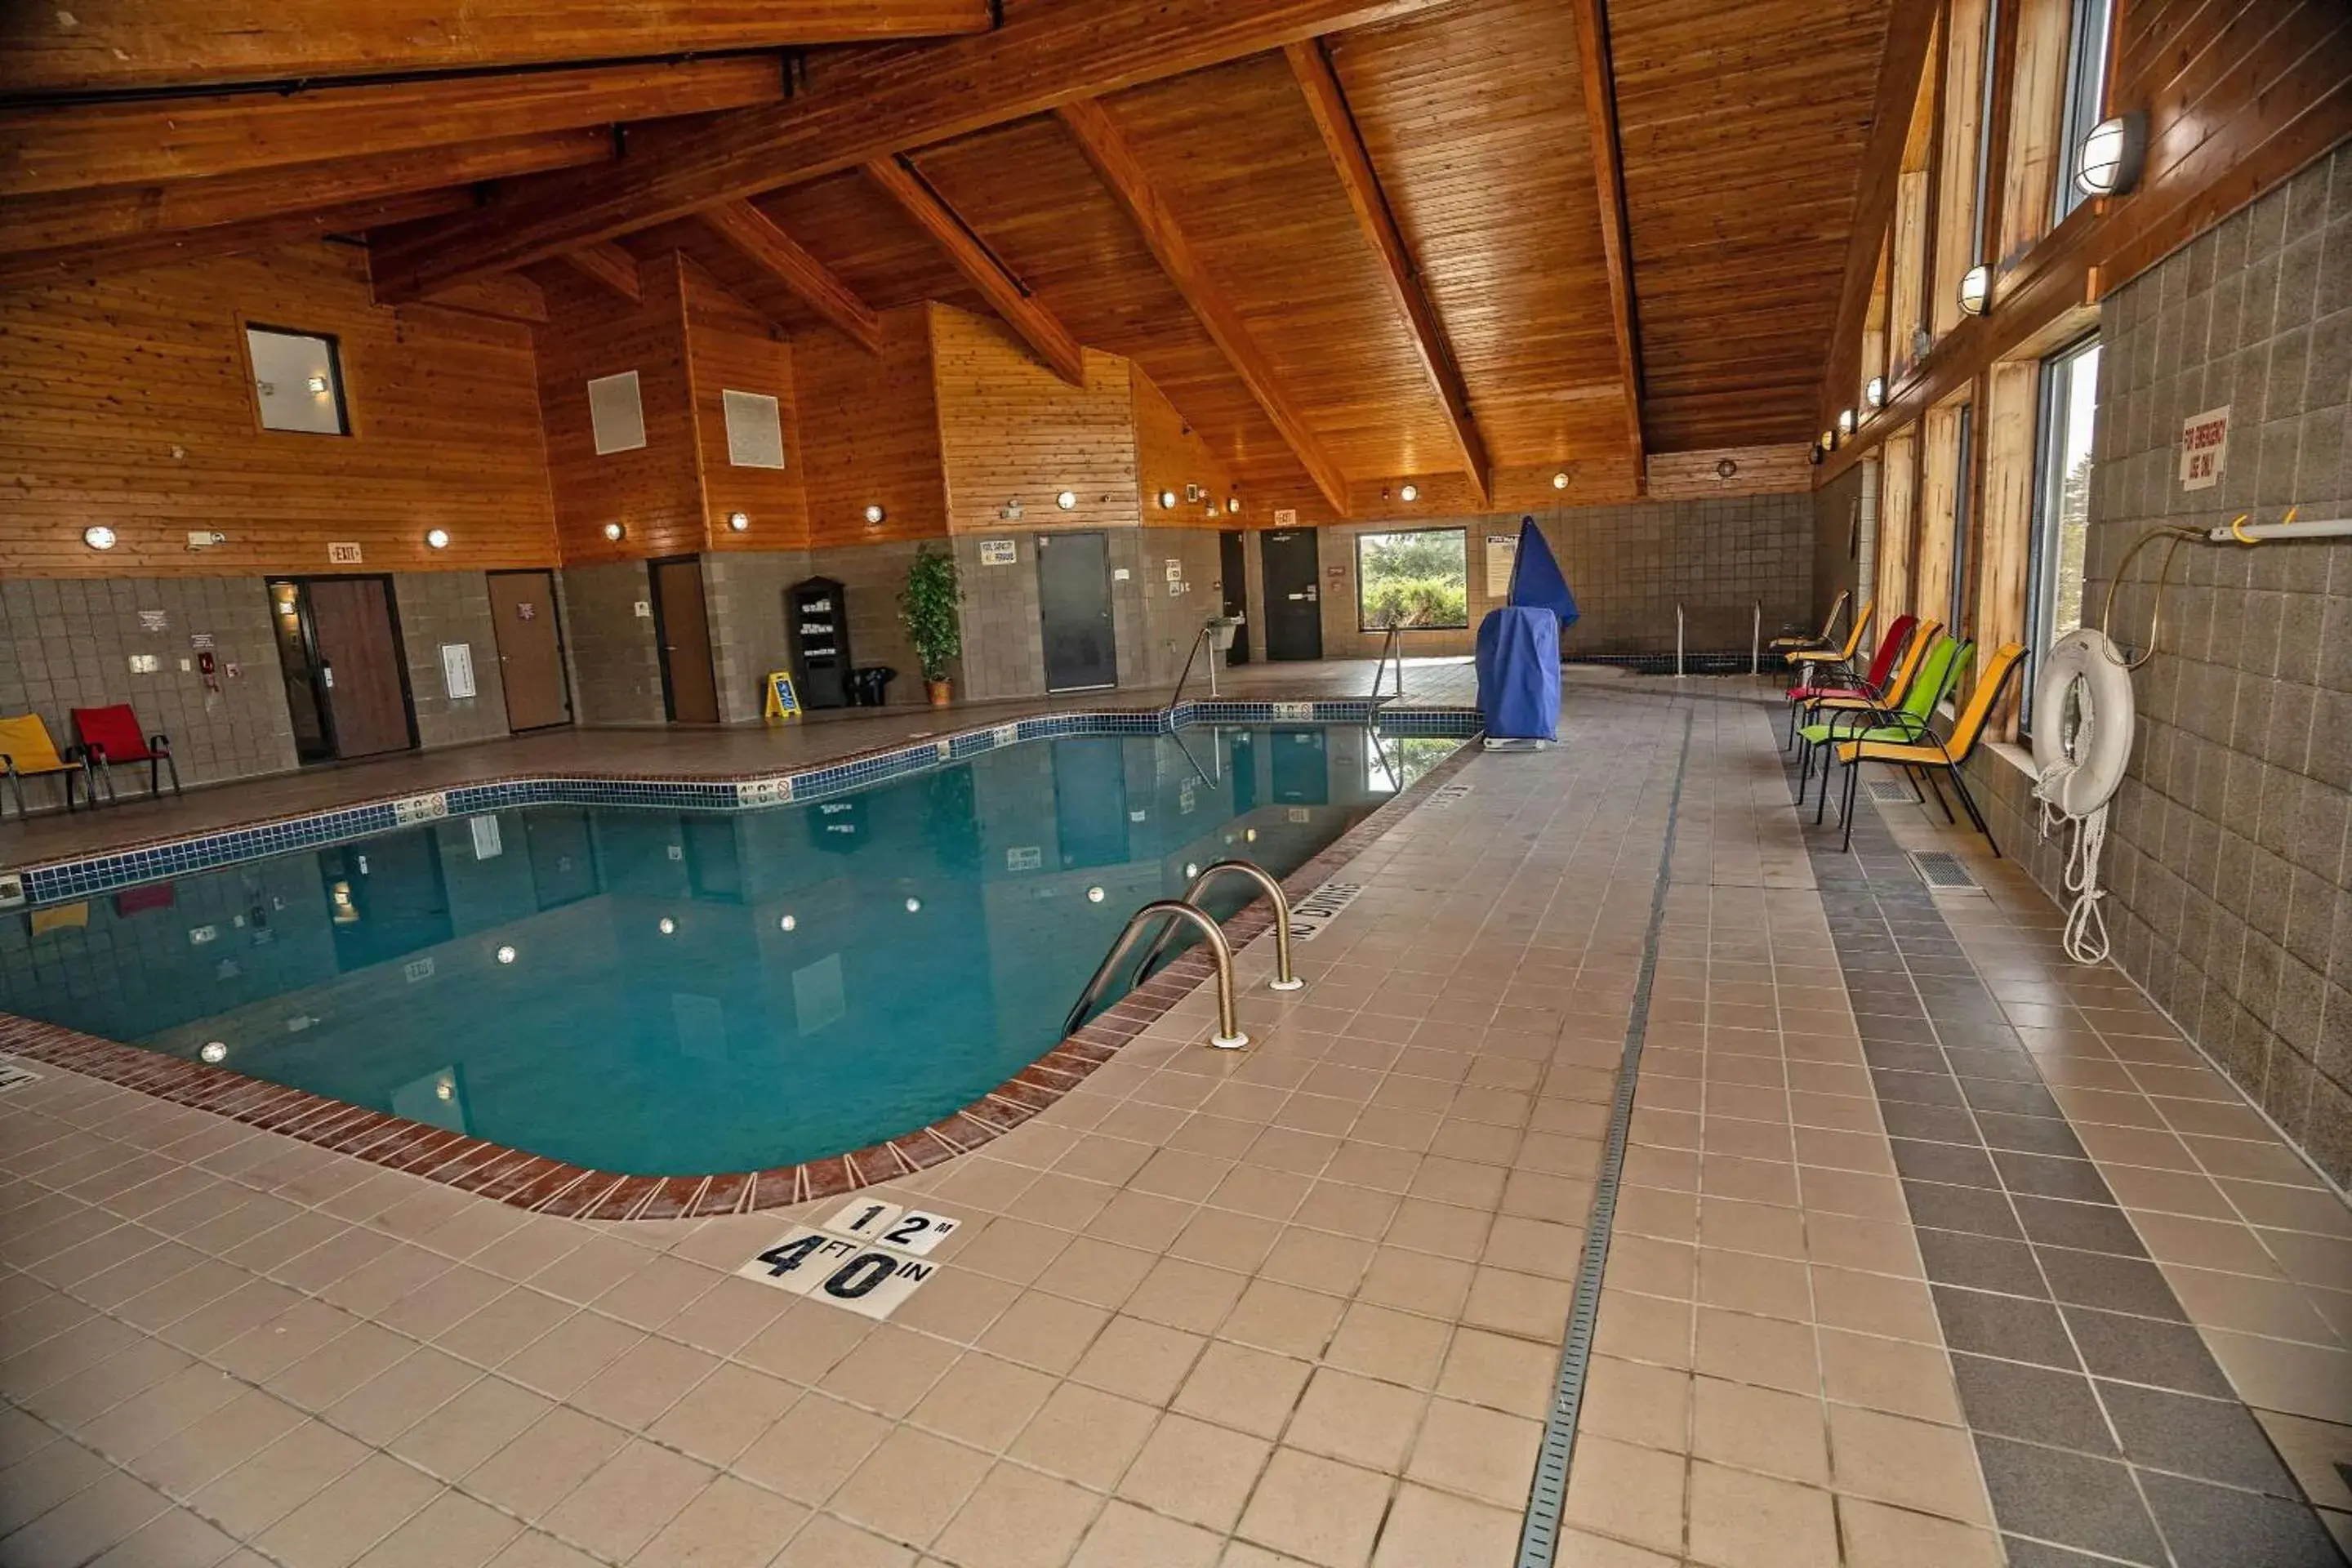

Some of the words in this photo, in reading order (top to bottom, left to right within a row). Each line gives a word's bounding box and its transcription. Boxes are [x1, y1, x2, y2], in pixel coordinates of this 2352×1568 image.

[1293, 883, 1361, 917] DIVING
[757, 1235, 827, 1277] 4
[819, 1241, 857, 1258] FT
[824, 1253, 898, 1298] 0
[896, 1262, 933, 1282] IN
